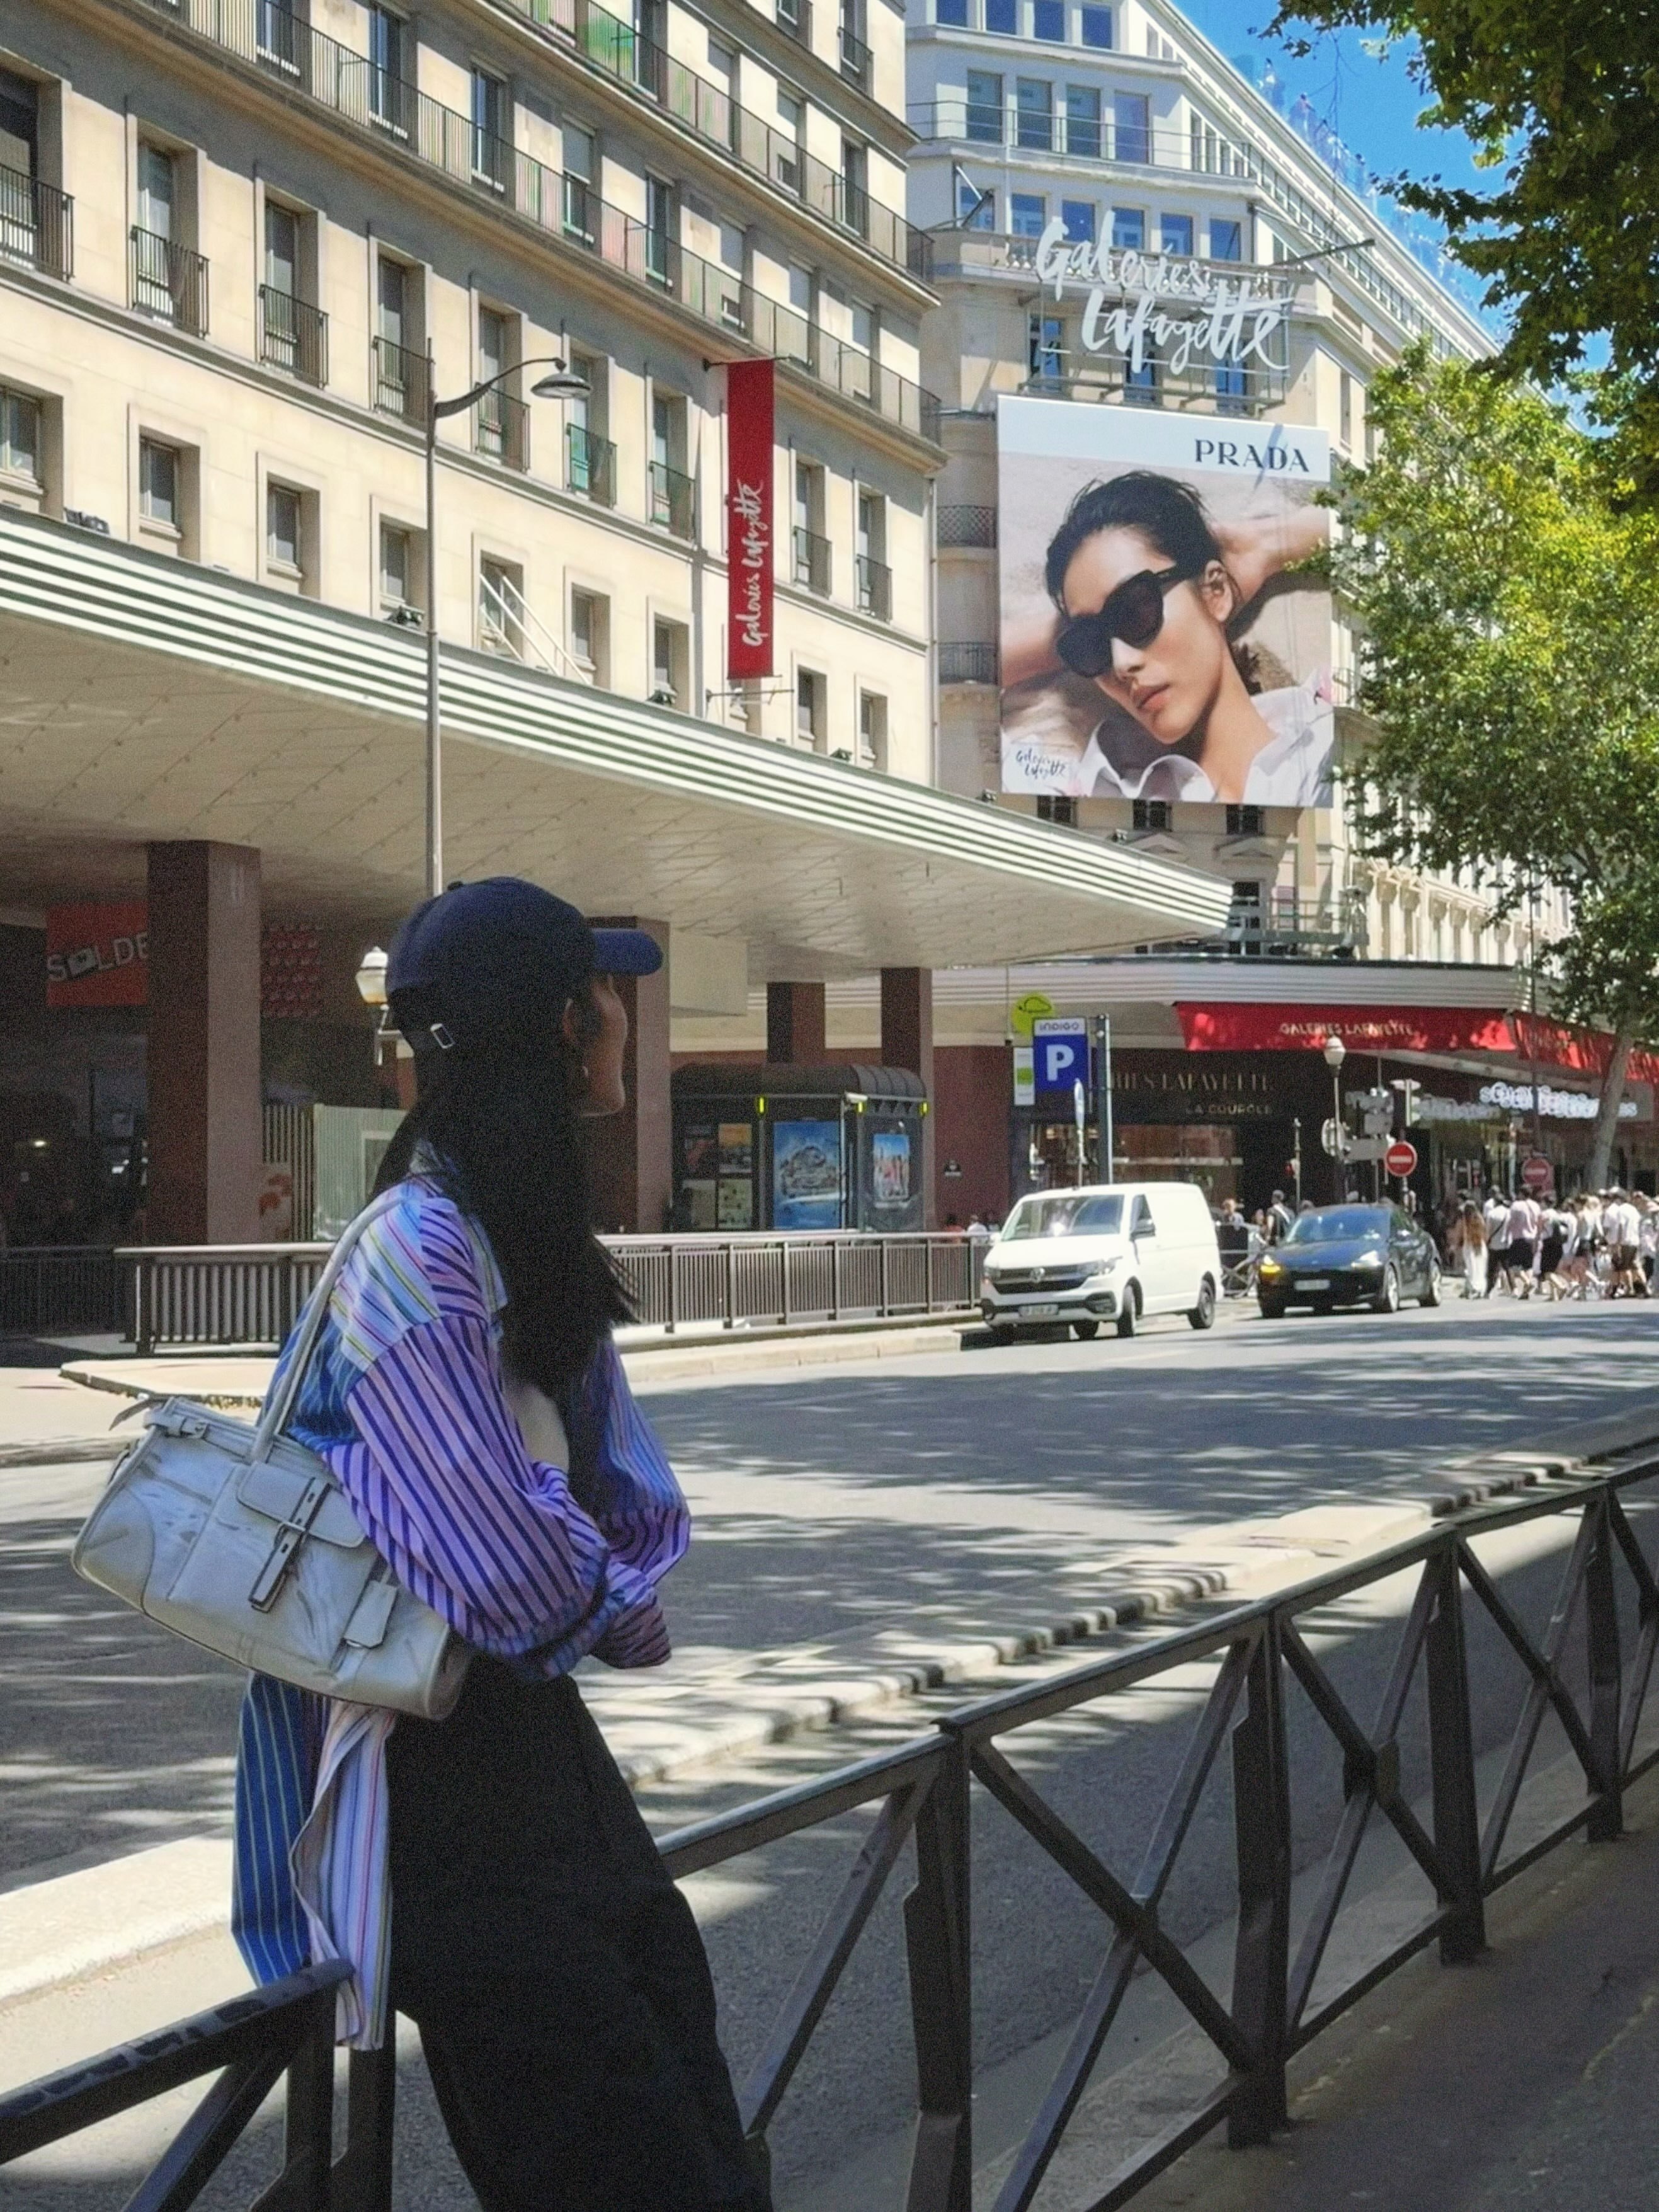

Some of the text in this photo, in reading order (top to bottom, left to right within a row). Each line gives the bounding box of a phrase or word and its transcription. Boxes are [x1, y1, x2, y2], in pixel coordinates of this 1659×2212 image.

[1037, 210, 1211, 301] Galeries
[1081, 280, 1294, 374] Lafayette
[1195, 438, 1309, 473] PRADA
[734, 478, 768, 567] Lafayette
[1280, 1023, 1342, 1035] GALERIES
[1046, 1044, 1075, 1081] P
